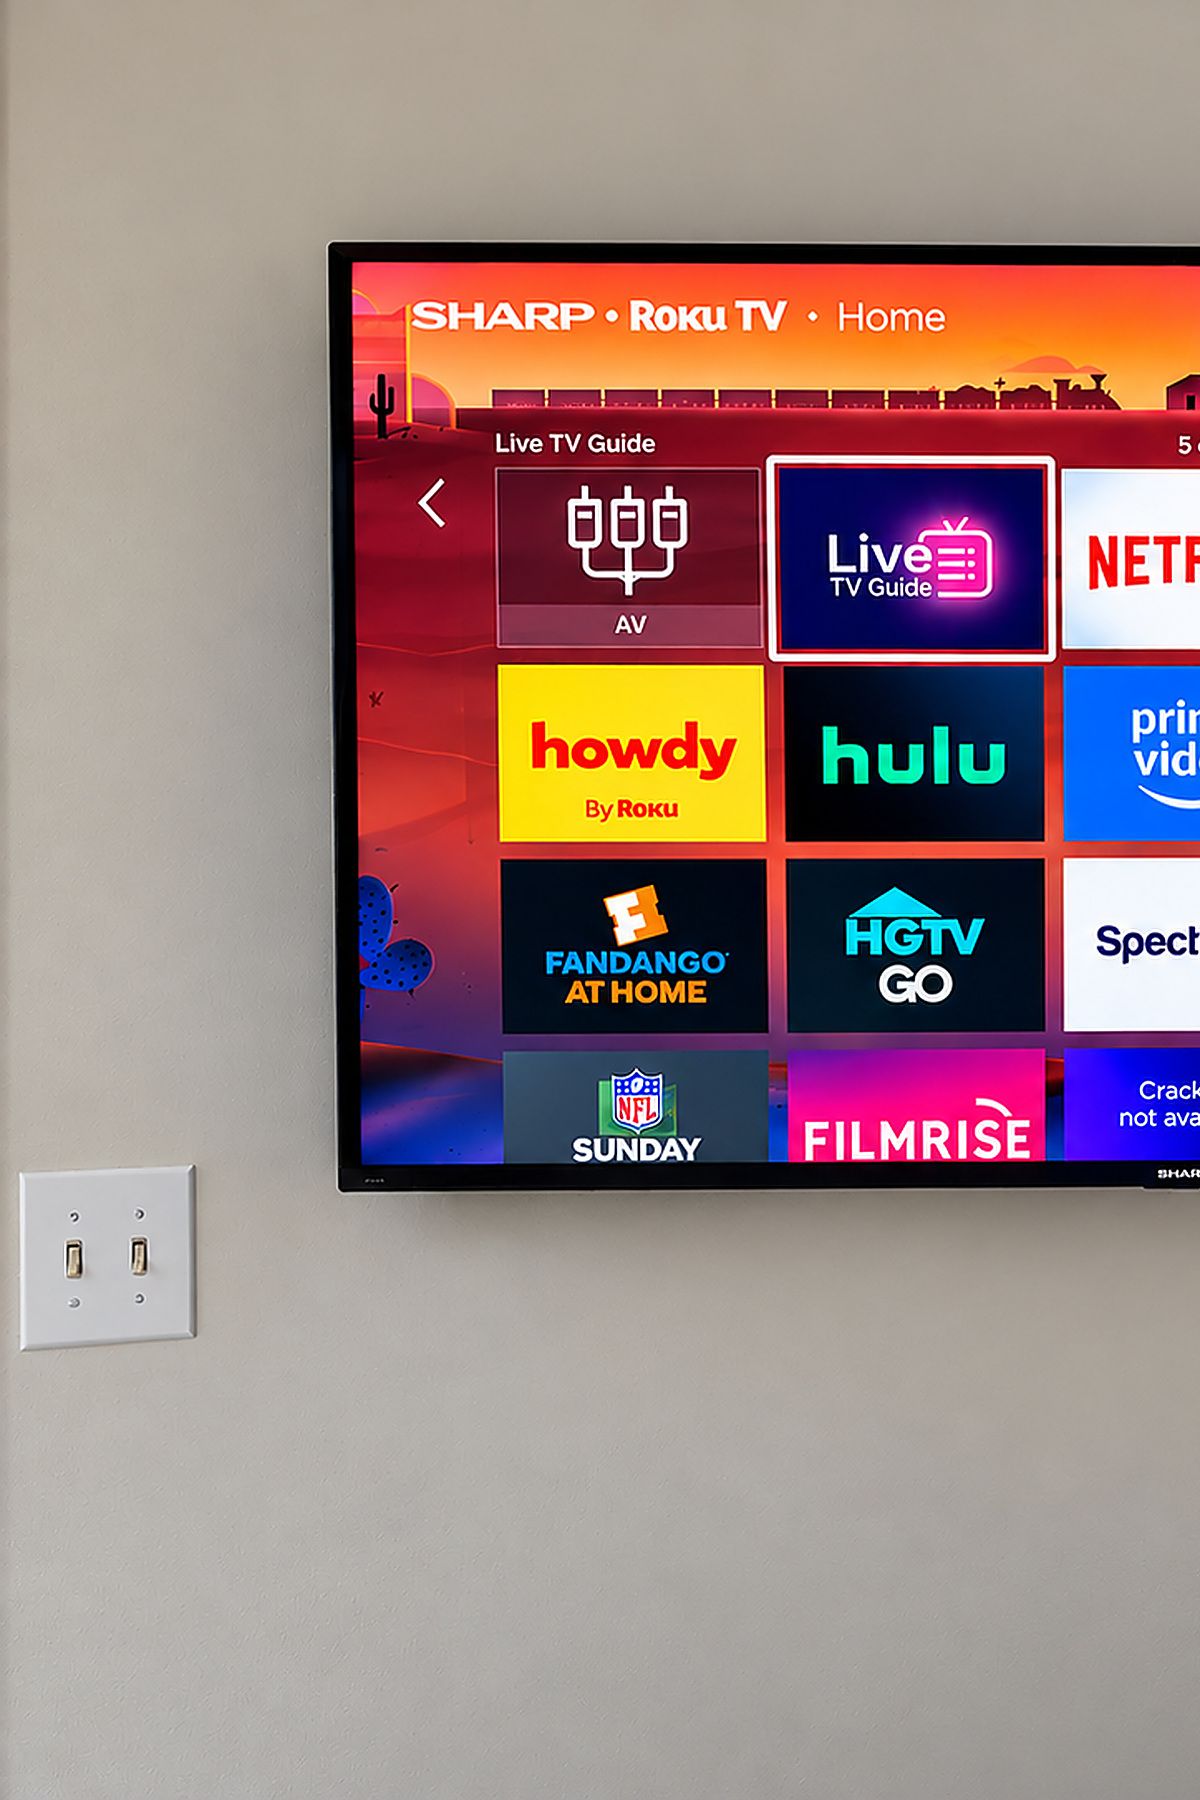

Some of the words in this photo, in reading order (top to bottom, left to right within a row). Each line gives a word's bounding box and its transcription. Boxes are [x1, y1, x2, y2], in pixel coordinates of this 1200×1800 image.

[411, 301, 596, 331] SHARP
[629, 300, 728, 332] Roku
[735, 300, 788, 331] TV
[838, 301, 947, 332] Home
[495, 433, 543, 454] Live
[548, 434, 582, 454] TV
[587, 433, 656, 454] Guide
[1178, 436, 1192, 455] 5
[828, 534, 933, 574] Live
[829, 578, 863, 597] TV
[870, 577, 933, 598] Guide
[614, 615, 647, 634] AV
[531, 721, 737, 780] howdy
[821, 725, 1006, 784] hulu
[585, 799, 613, 822] By
[617, 799, 679, 818] Roku
[845, 918, 985, 955] HGTV
[546, 951, 727, 974] FANDANGO
[564, 980, 605, 1004] AT
[611, 980, 707, 1004] HOME
[878, 964, 953, 1003] GO
[619, 1096, 657, 1123] NFL
[1119, 1109, 1156, 1127] not
[572, 1137, 702, 1162] SUNDAY
[804, 1119, 1031, 1160] FILMRISE
